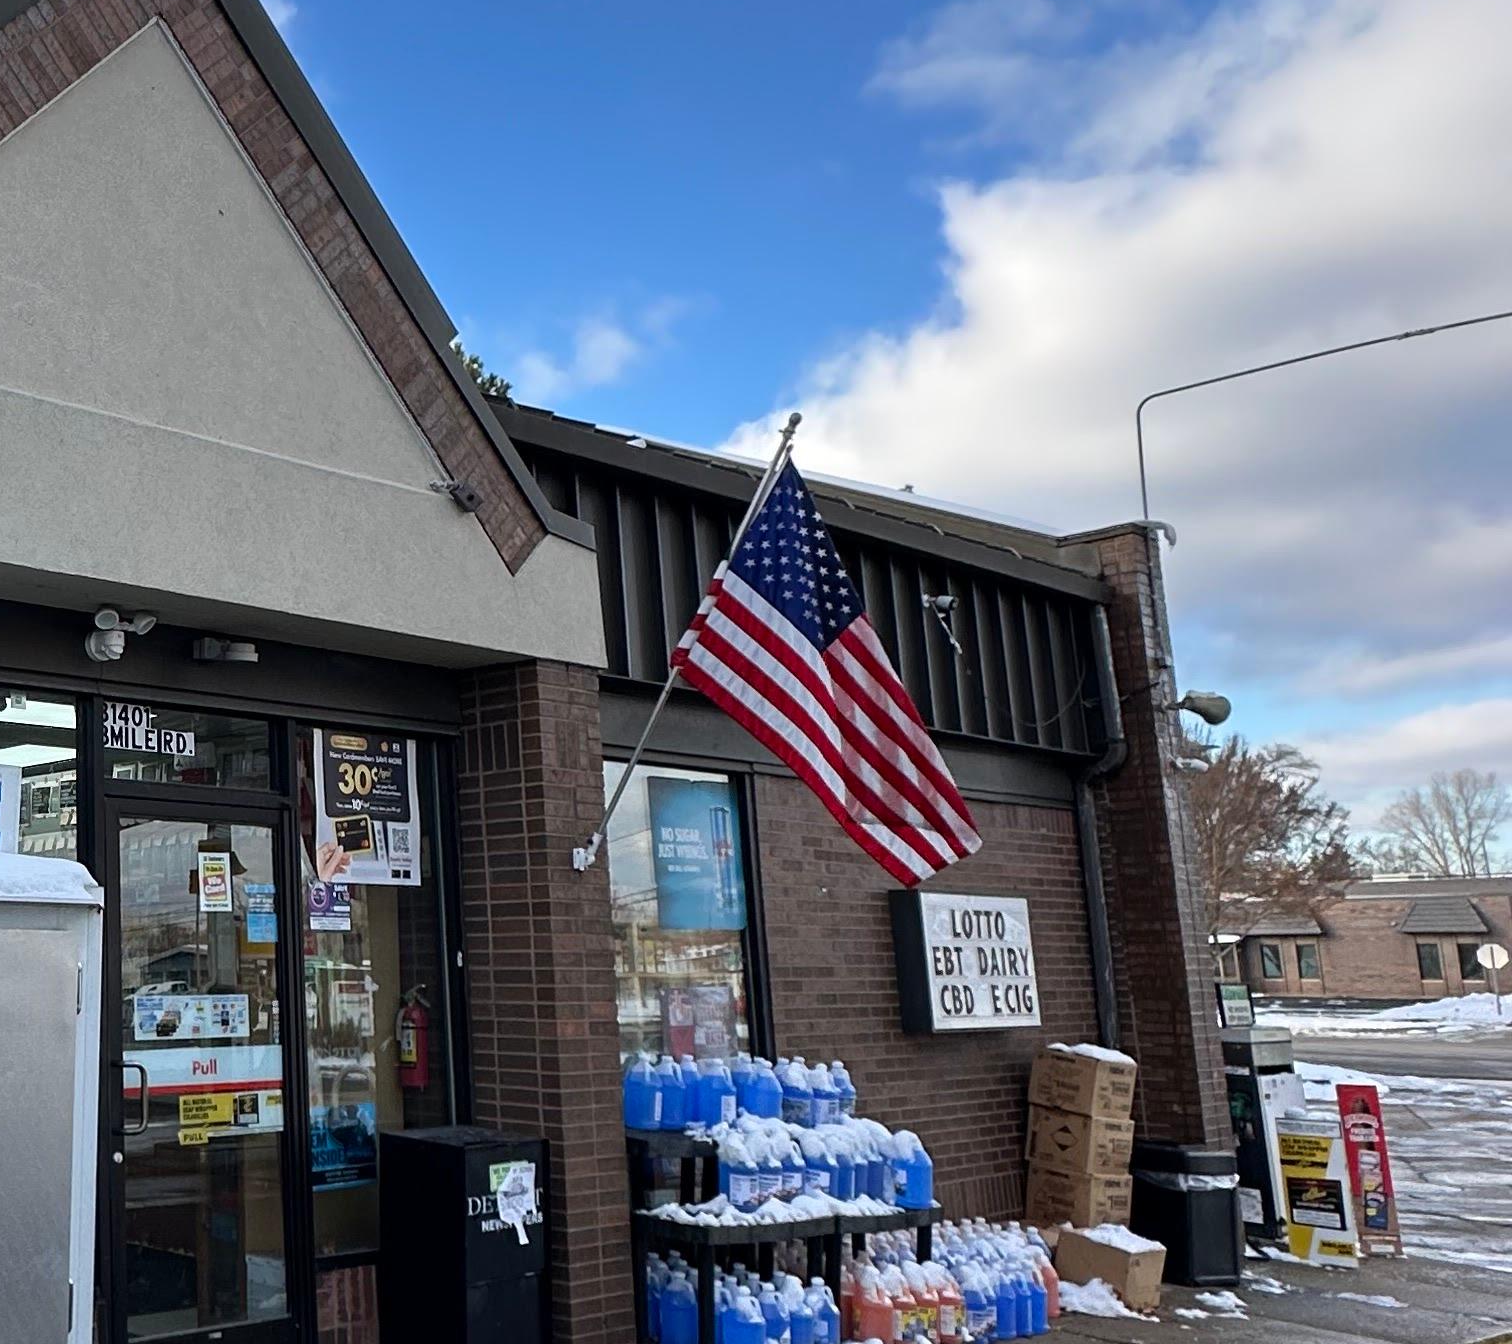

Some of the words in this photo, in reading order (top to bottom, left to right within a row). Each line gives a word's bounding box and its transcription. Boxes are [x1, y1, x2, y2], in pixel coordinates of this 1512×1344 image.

[163, 731, 193, 755] RD.
[951, 909, 1005, 939] LOTTO
[932, 946, 963, 976] EBT
[977, 946, 1029, 976] DAIRY
[941, 985, 975, 1015] CBD
[192, 1059, 218, 1075] Pull
[183, 1132, 203, 1142] PULL
